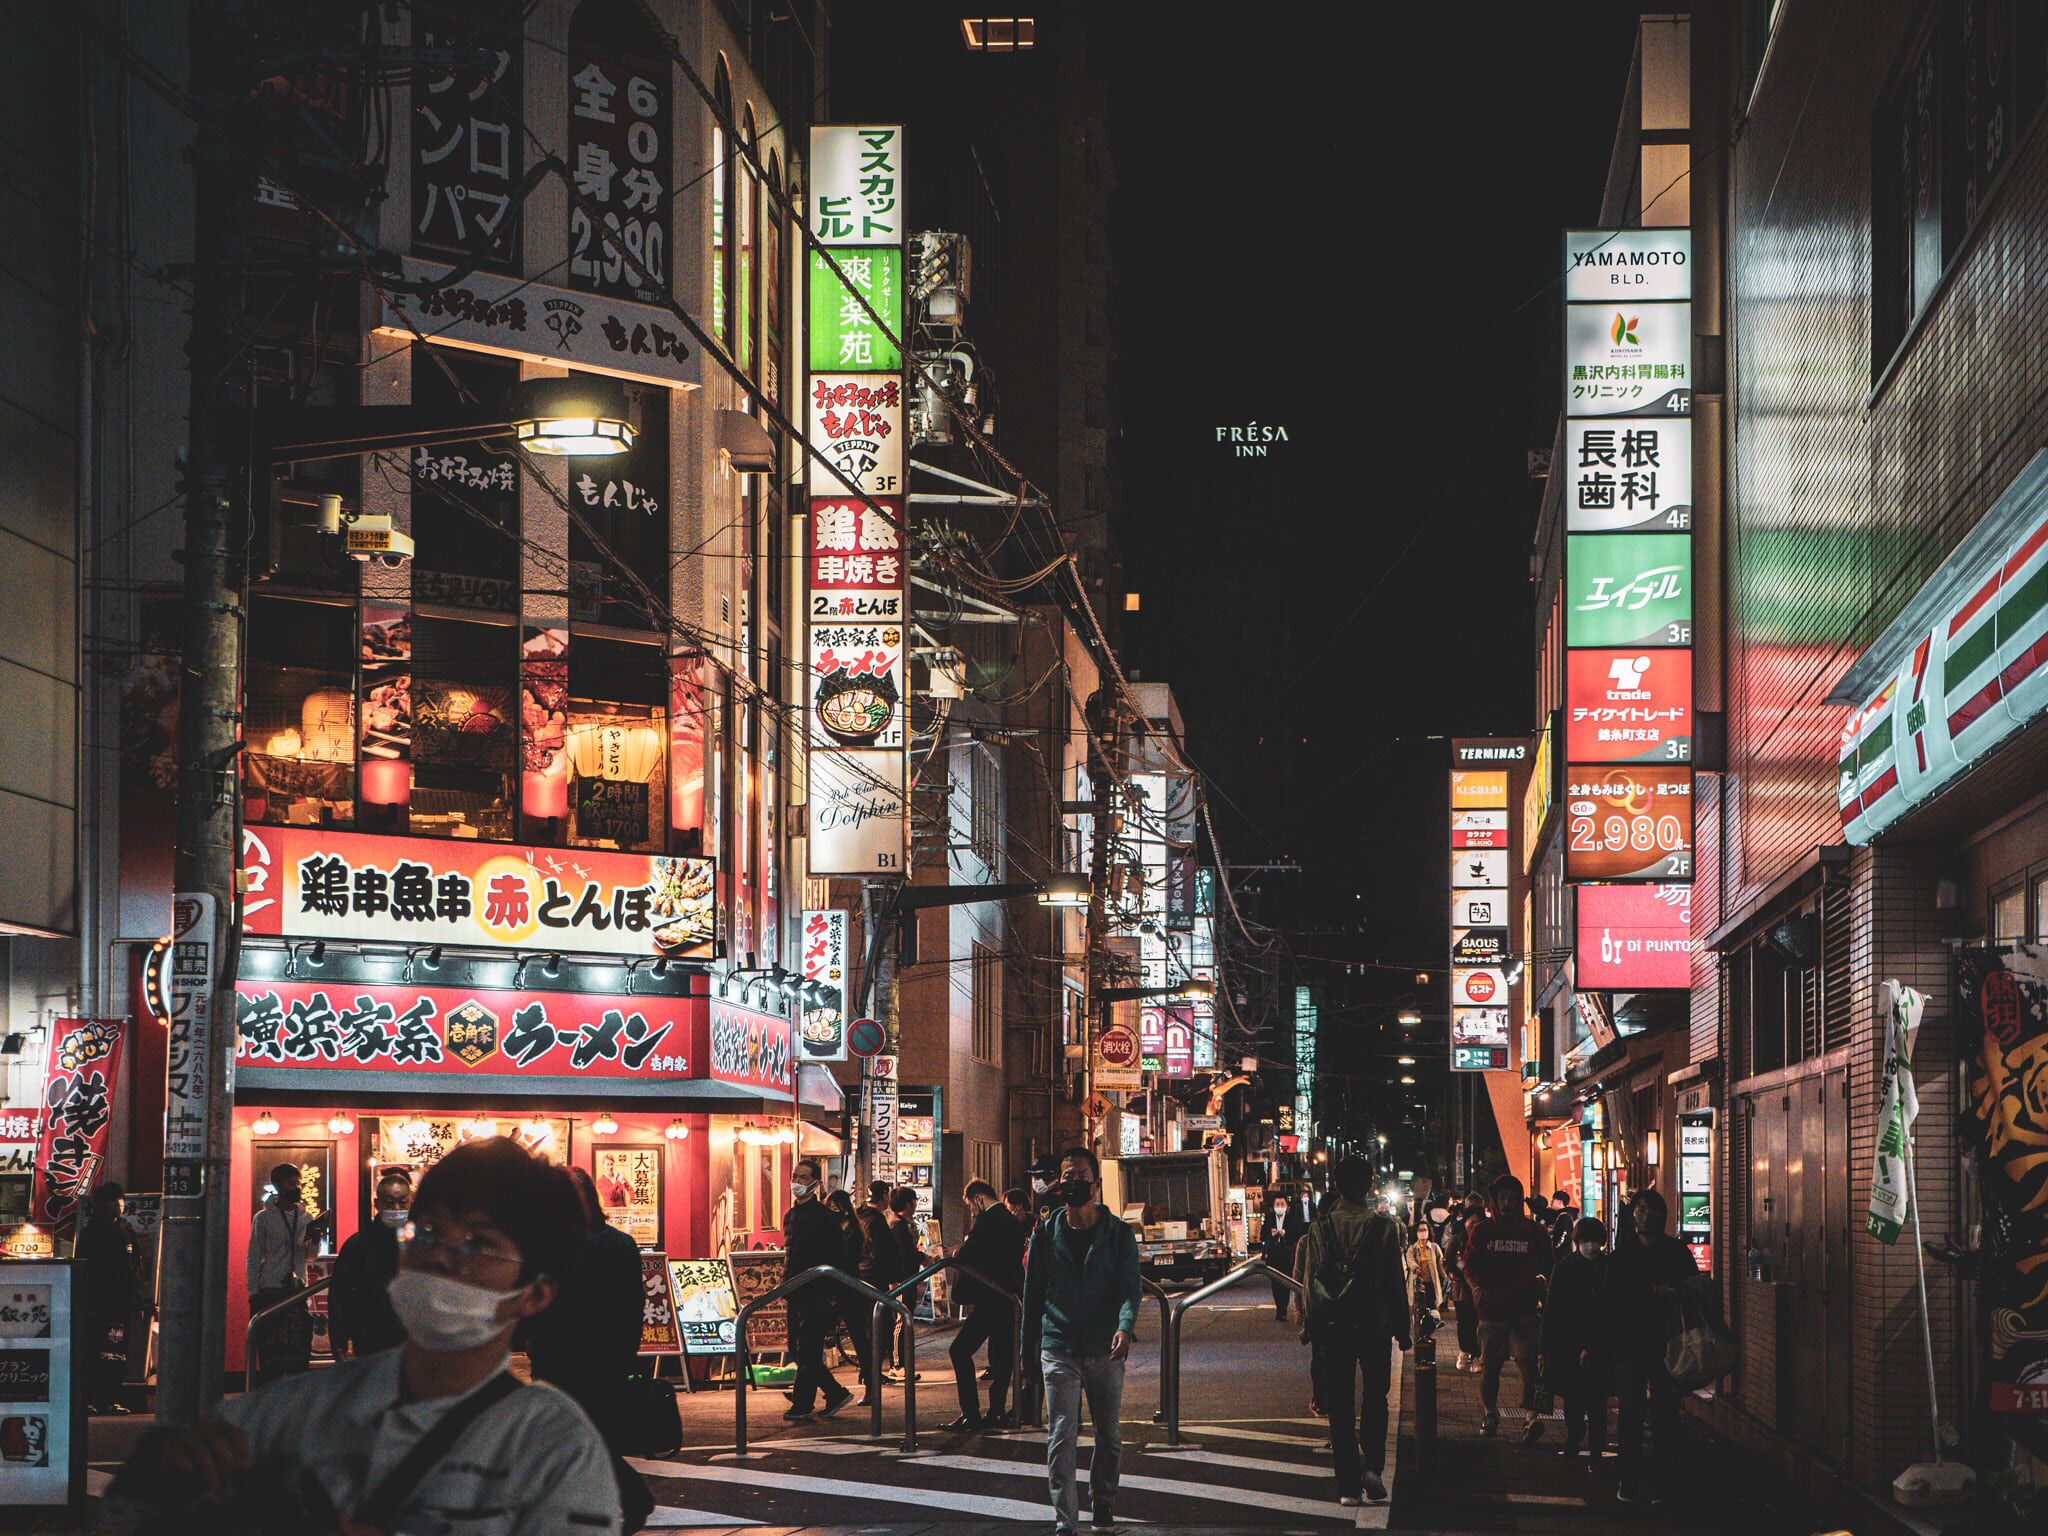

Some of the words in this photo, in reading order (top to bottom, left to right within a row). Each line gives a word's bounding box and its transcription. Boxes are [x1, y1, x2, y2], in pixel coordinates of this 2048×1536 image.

[858, 130, 895, 238] マスカット
[817, 196, 853, 238] ビル
[1573, 251, 1686, 266] YAMAMOTO
[1611, 274, 1649, 284] BLD.
[1572, 364, 1685, 380] 黒沢内科胃腸科
[1572, 384, 1643, 399] クリニック
[1667, 393, 1688, 412] 4F
[820, 410, 891, 438] もんじゃ
[1236, 445, 1267, 456] INN
[1578, 429, 1660, 468] 長根
[876, 476, 897, 490] 3F
[1578, 471, 1660, 510] 歯科
[576, 474, 660, 515] もんじゃ
[1666, 510, 1689, 528] 4F
[817, 556, 900, 584] 串焼き
[1575, 565, 1685, 611] エイブル
[813, 627, 880, 648] 横浜家系
[1668, 624, 1690, 642] 3F
[815, 649, 900, 678] ラーメン
[1607, 690, 1651, 700] trade
[1573, 707, 1683, 721] テイケイトレード
[881, 731, 901, 743] 1F
[609, 730, 620, 775] やきとり
[1666, 740, 1688, 759] 3F
[817, 799, 898, 831] Dolphin
[878, 854, 897, 867] B1
[1667, 856, 1689, 875] 2F
[302, 856, 470, 924] 鶏串魚串
[486, 875, 656, 930] 赤とんぼ
[805, 914, 828, 980] ラーメン
[1462, 939, 1499, 948] BAGUS
[1646, 940, 1690, 951] PUNTO
[181, 978, 207, 986] SHOP
[1469, 985, 1493, 994] ガスト
[503, 1000, 674, 1068] ラーメン
[1103, 1040, 1130, 1054] 消火栓
[876, 1103, 890, 1154] フクシマ
[634, 1153, 649, 1205] 大募集
